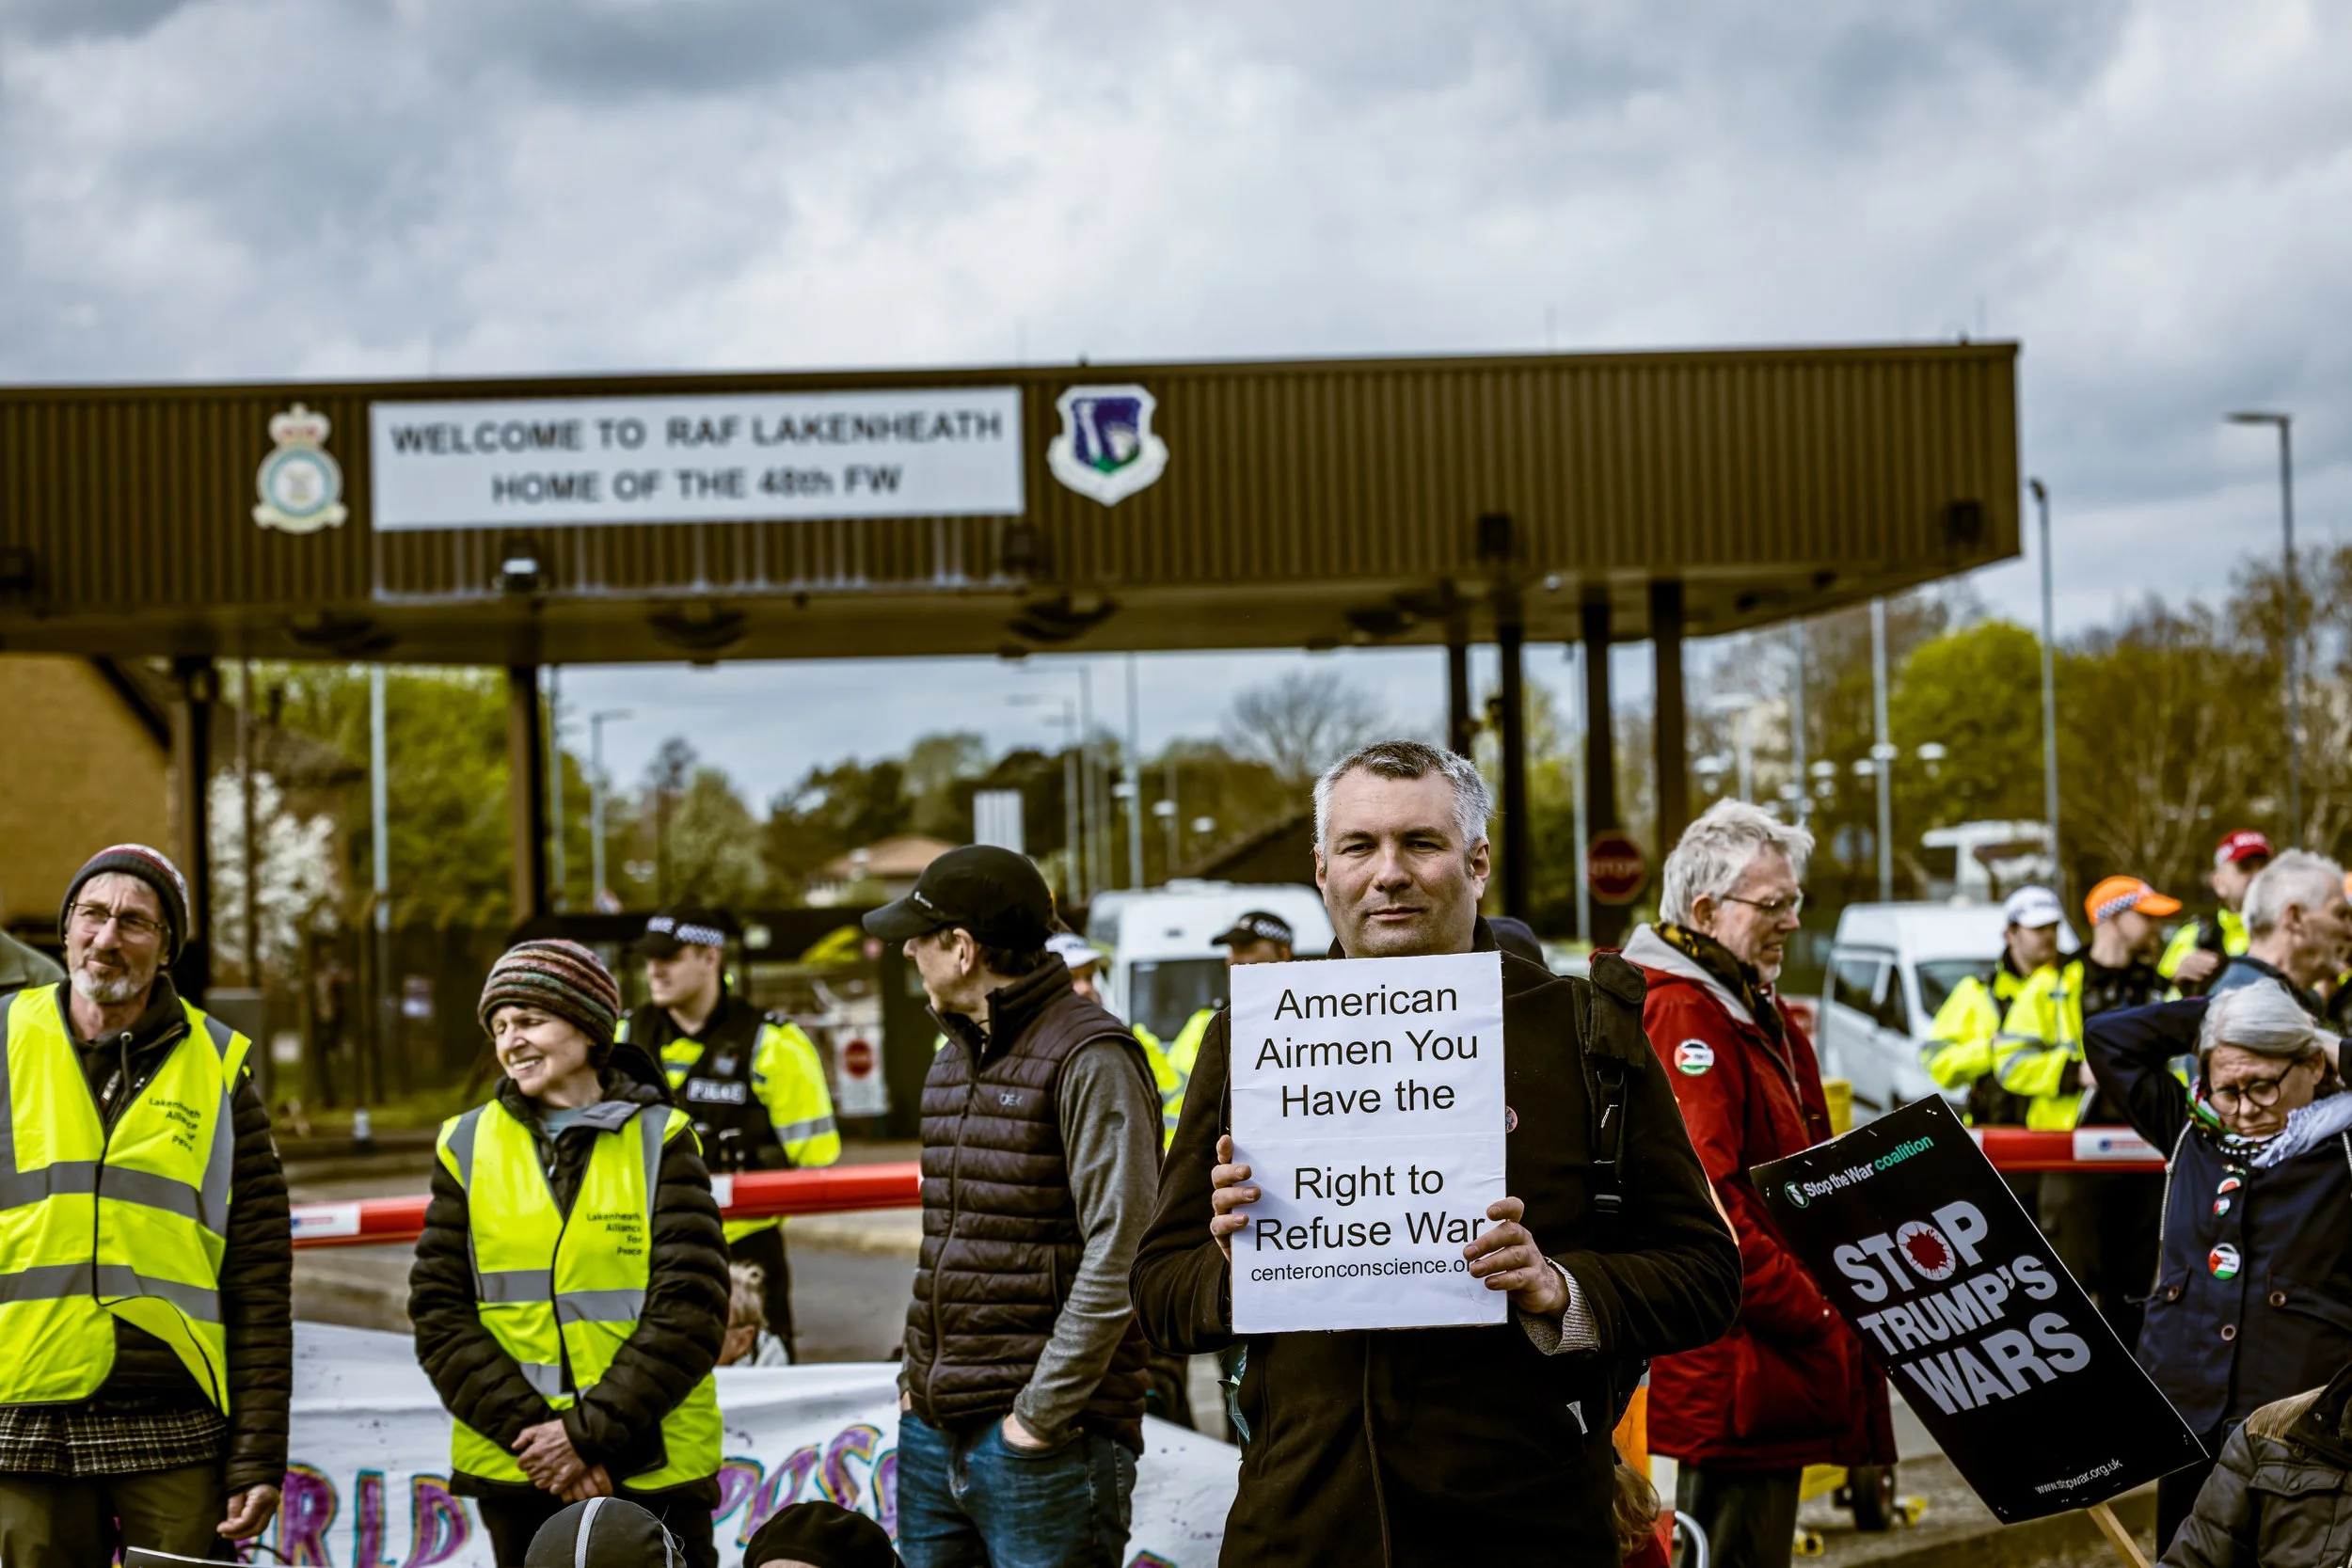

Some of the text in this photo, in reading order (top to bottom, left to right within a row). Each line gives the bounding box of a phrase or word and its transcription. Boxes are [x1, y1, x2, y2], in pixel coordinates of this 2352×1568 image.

[390, 409, 1003, 454] WELCOME TO RAF LAKENHEATH
[491, 464, 903, 505] HOME OF THE 48th FW
[1274, 984, 1457, 1021] American
[1255, 1029, 1478, 1070] Airmen You
[1281, 1079, 1454, 1117] Have the
[1295, 1164, 1444, 1207] Right to
[1803, 1135, 1935, 1198] Stop the War coalition
[1255, 1211, 1486, 1252] Refuse War
[1833, 1200, 1989, 1304] STOP
[1250, 1258, 1470, 1282] centeronconscience.or
[1857, 1255, 2058, 1357] TRUMP'S
[1900, 1312, 2091, 1416] WARS
